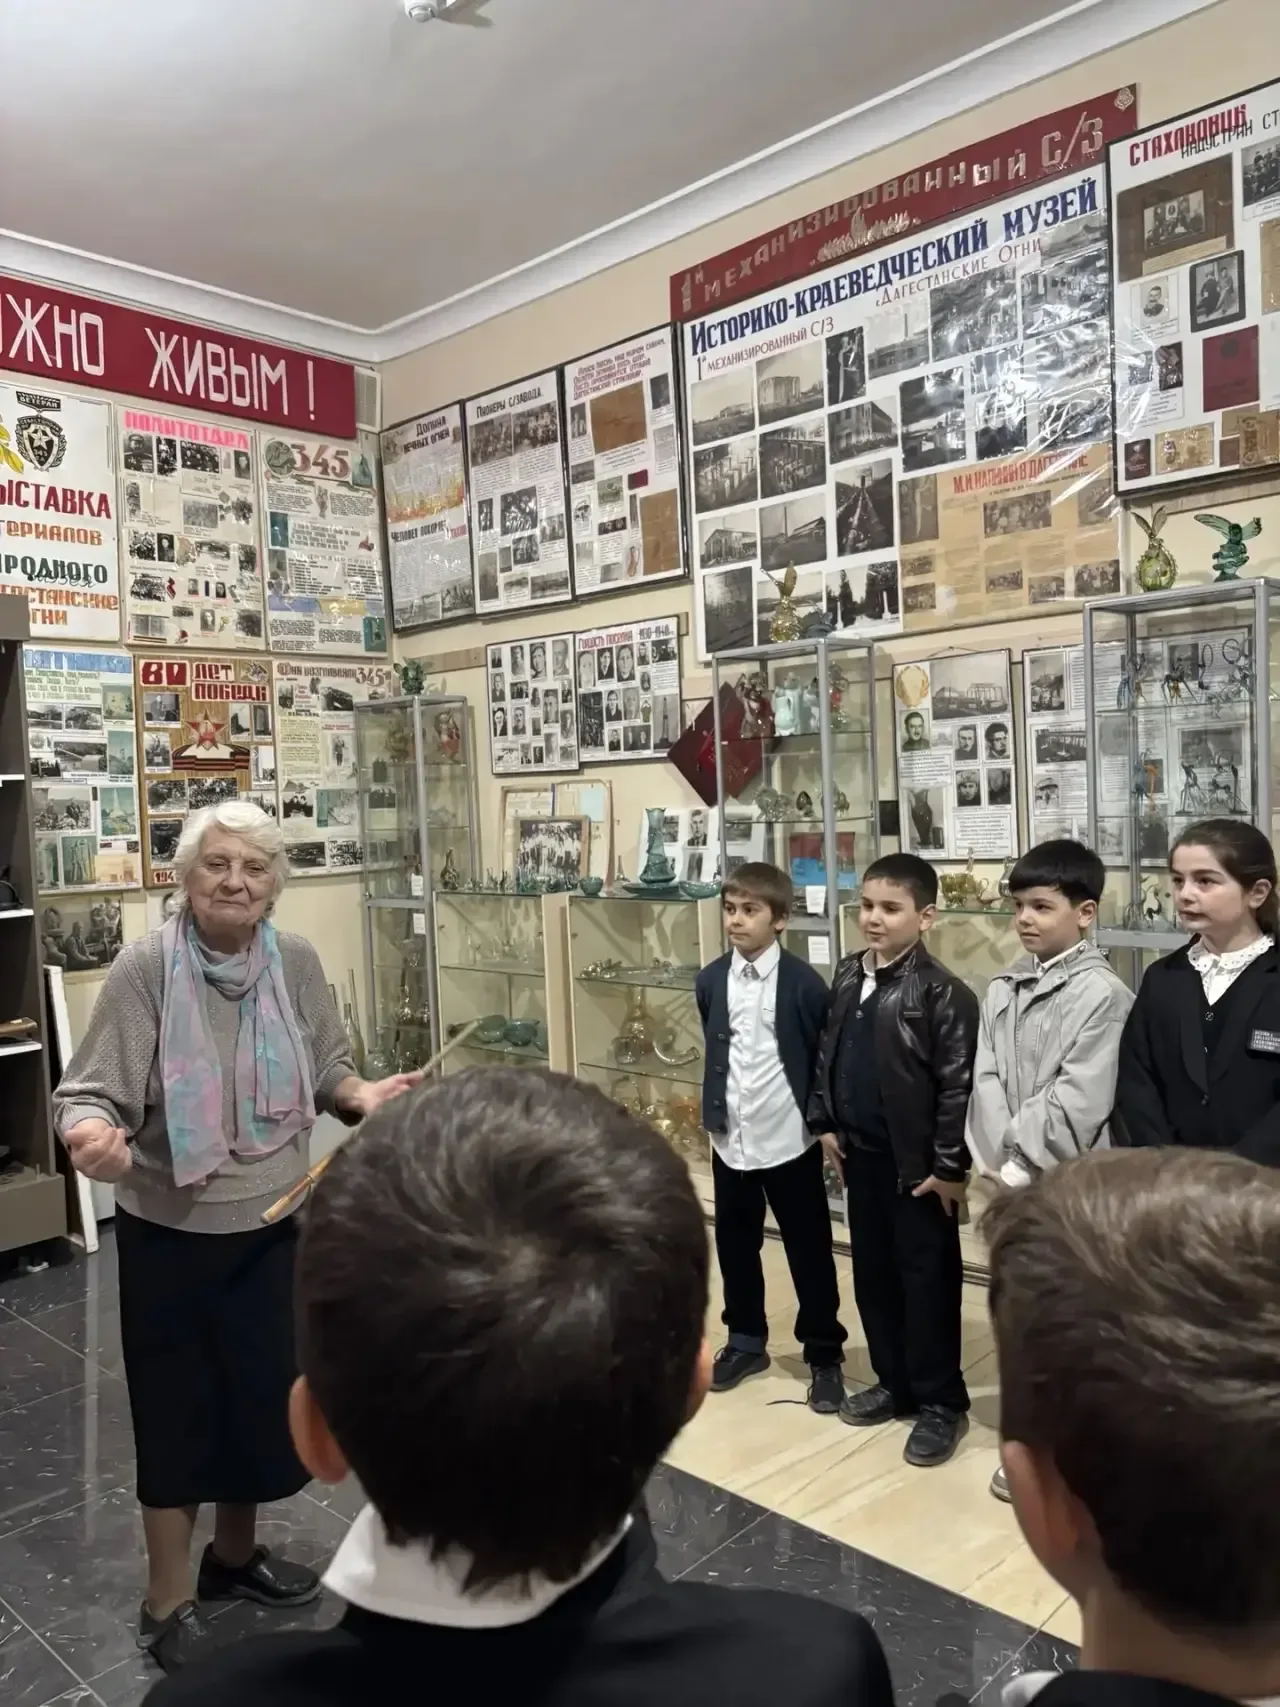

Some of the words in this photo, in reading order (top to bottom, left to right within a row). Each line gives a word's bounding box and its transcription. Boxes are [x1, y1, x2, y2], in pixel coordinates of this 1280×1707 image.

[1041, 111, 1103, 167] С/З
[691, 218, 988, 356] ИСТОРИКО-КРАЕВЕДЧЕСКИЙ
[1002, 177, 1098, 243] МУЗЕЙ
[0, 291, 105, 376] ЖНО
[707, 327, 808, 372] МЕХАНИЗИРОВАННЫЙ
[810, 316, 835, 337] С/З
[290, 443, 350, 478] 345
[0, 553, 108, 584] РОДНОГО
[31, 608, 68, 625] ГНИ
[141, 661, 187, 686] 80
[194, 683, 267, 701] ПОБЕДЫ
